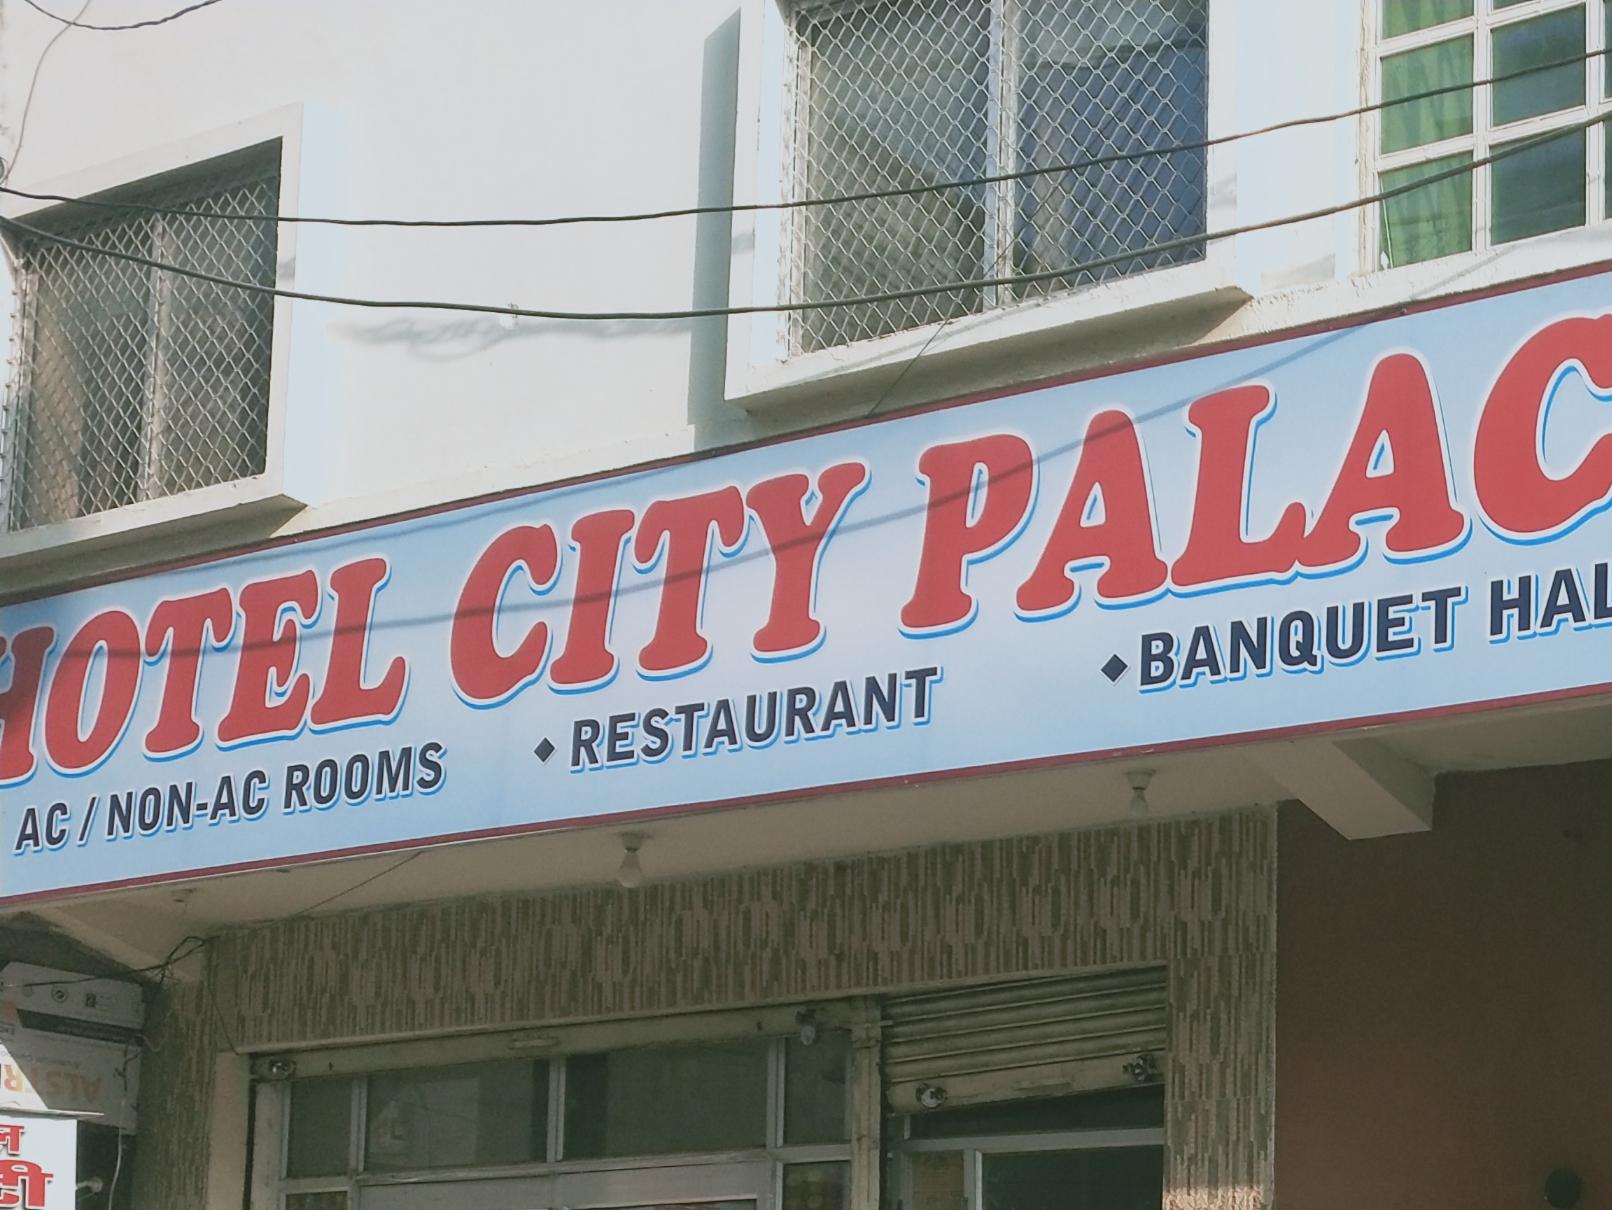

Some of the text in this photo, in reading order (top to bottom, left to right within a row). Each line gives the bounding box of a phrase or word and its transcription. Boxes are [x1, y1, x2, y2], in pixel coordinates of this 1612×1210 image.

[0, 556, 409, 782] HOTEL
[449, 461, 868, 703] CITY
[1140, 586, 1464, 687] BANQUET
[570, 666, 938, 768] RESTAURANT
[14, 802, 69, 852] AC
[106, 768, 269, 837] NON-AC
[283, 741, 445, 811] ROOMS
